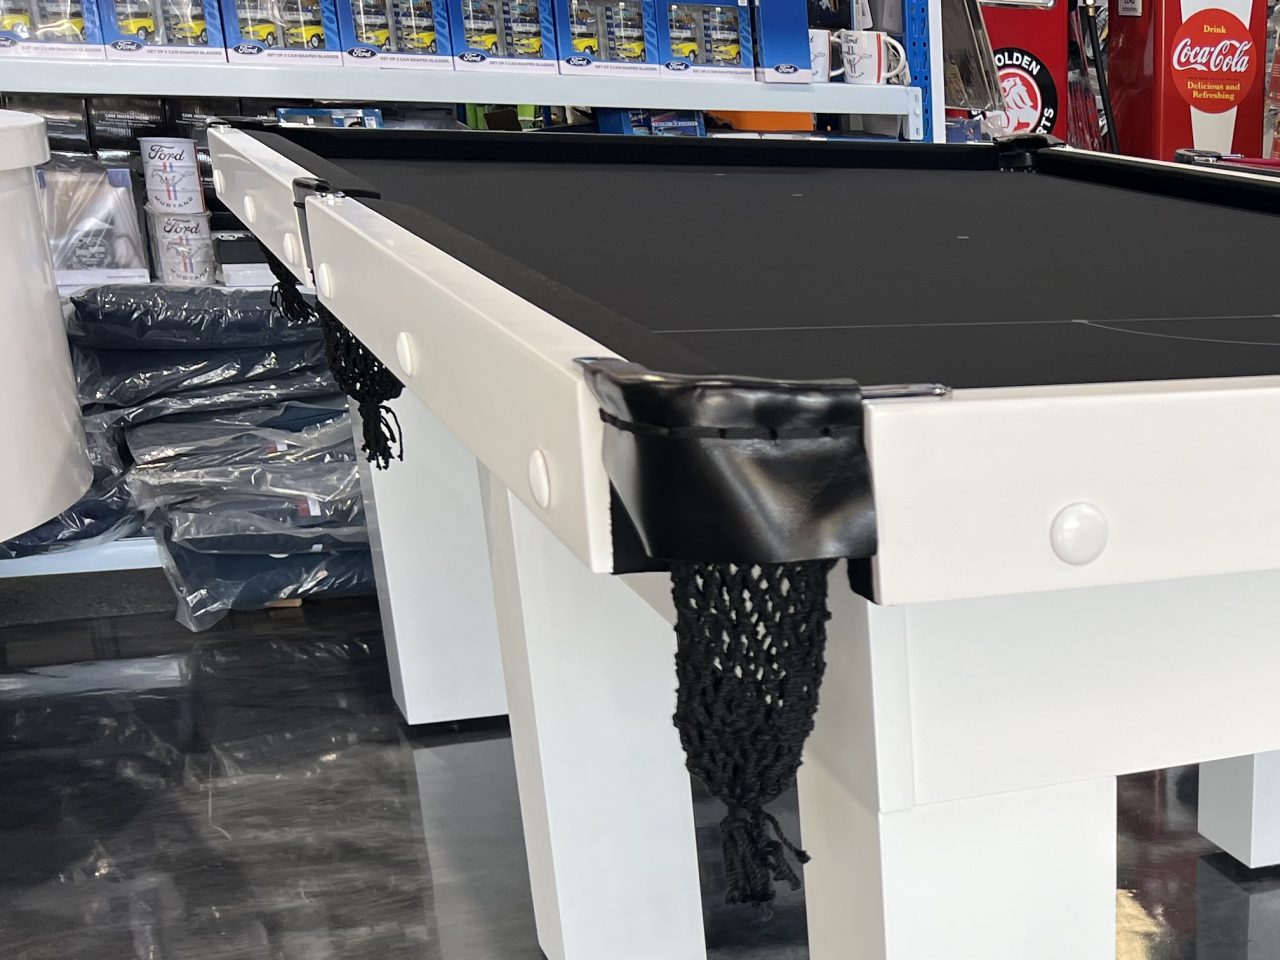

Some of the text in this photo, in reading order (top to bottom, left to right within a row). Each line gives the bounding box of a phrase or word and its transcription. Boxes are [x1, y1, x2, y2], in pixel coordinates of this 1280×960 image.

[1203, 25, 1227, 34] Drink
[0, 37, 12, 47] ord
[843, 33, 858, 44] Ford
[115, 40, 138, 50] Ford
[237, 44, 260, 54] Ford
[351, 48, 373, 58] Ford
[462, 52, 482, 62] Ford
[1172, 38, 1253, 73] Coca-Cola
[568, 56, 588, 66] Ford
[668, 61, 687, 71] Ford
[994, 51, 1041, 76] OLDEN
[778, 64, 796, 74] Ford
[1187, 81, 1241, 91] Delicious and
[1192, 90, 1235, 101] Refreshing
[148, 144, 185, 162] Ford
[154, 195, 194, 209] MUSTANG
[163, 217, 201, 235] Ford
